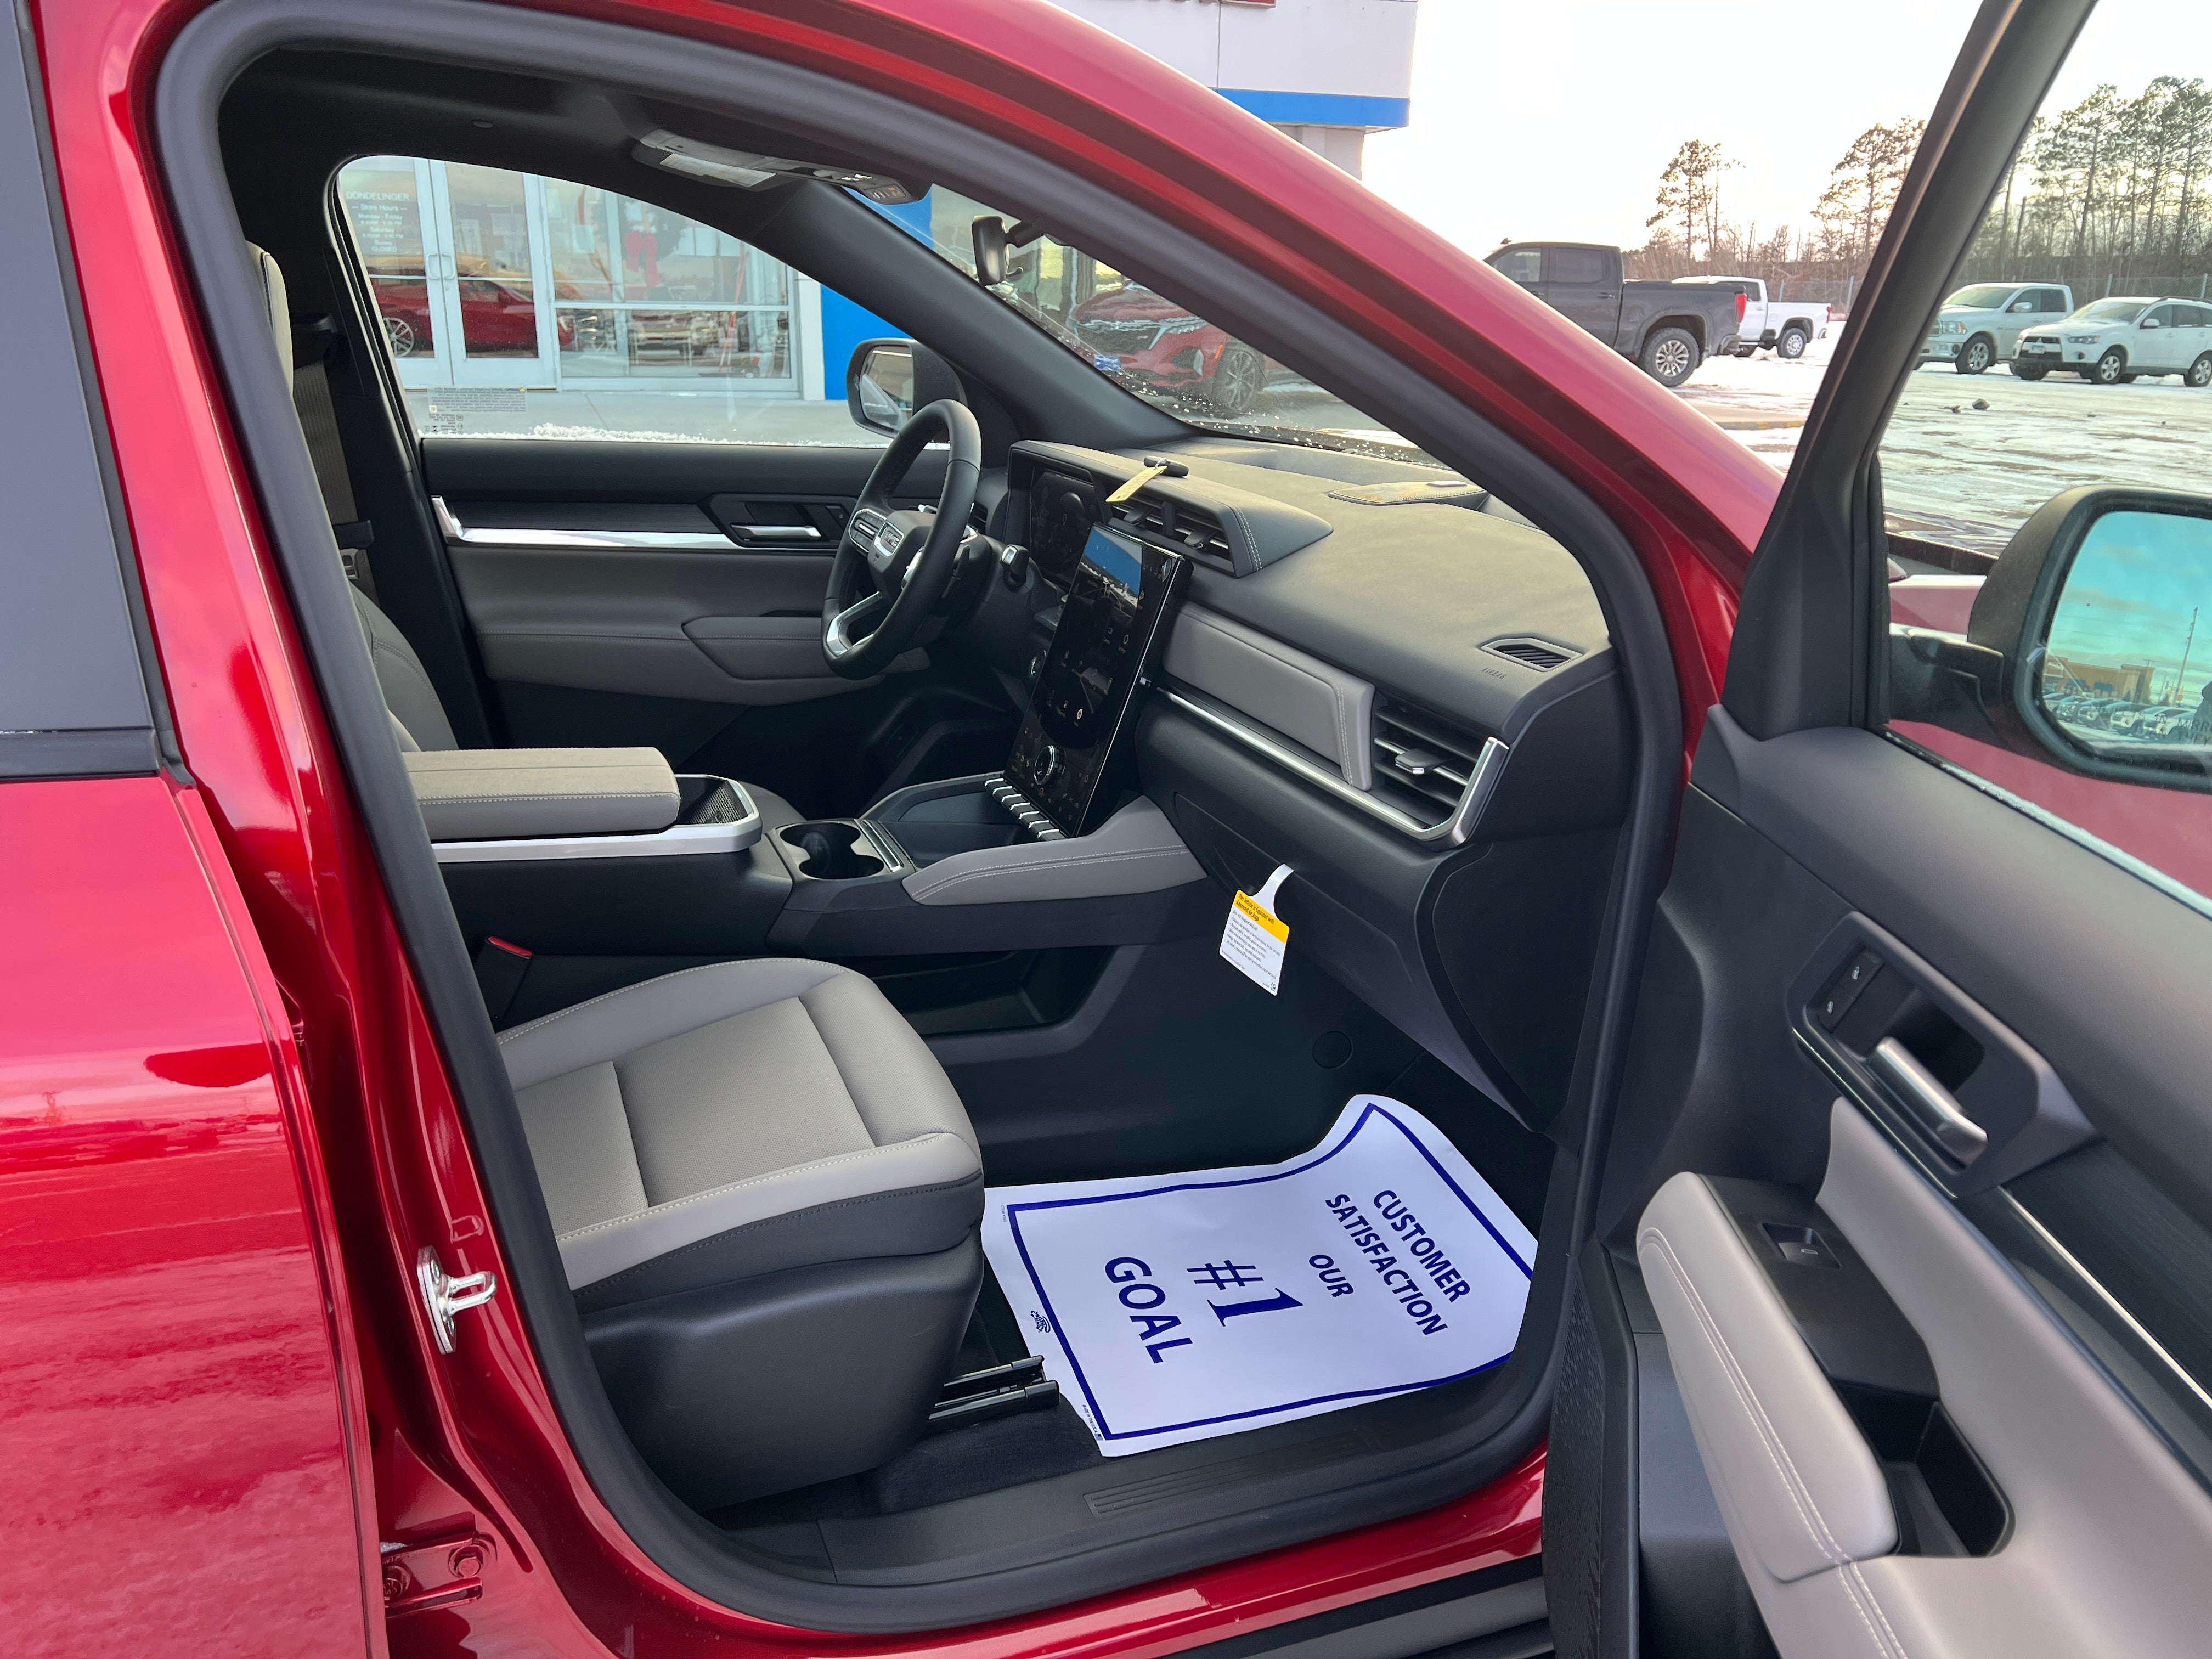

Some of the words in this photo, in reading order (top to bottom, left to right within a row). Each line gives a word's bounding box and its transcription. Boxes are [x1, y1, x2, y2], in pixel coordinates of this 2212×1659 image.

[346, 191, 410, 201] DONDELINGER
[1480, 668, 1507, 679] AIRBAG
[1309, 1255, 1353, 1297] OUR
[1325, 1194, 1448, 1335] SATISFACTION
[1374, 1190, 1470, 1302] CUSTOMER
[1105, 1257, 1193, 1363] GOAL
[1187, 1260, 1304, 1327] #1
